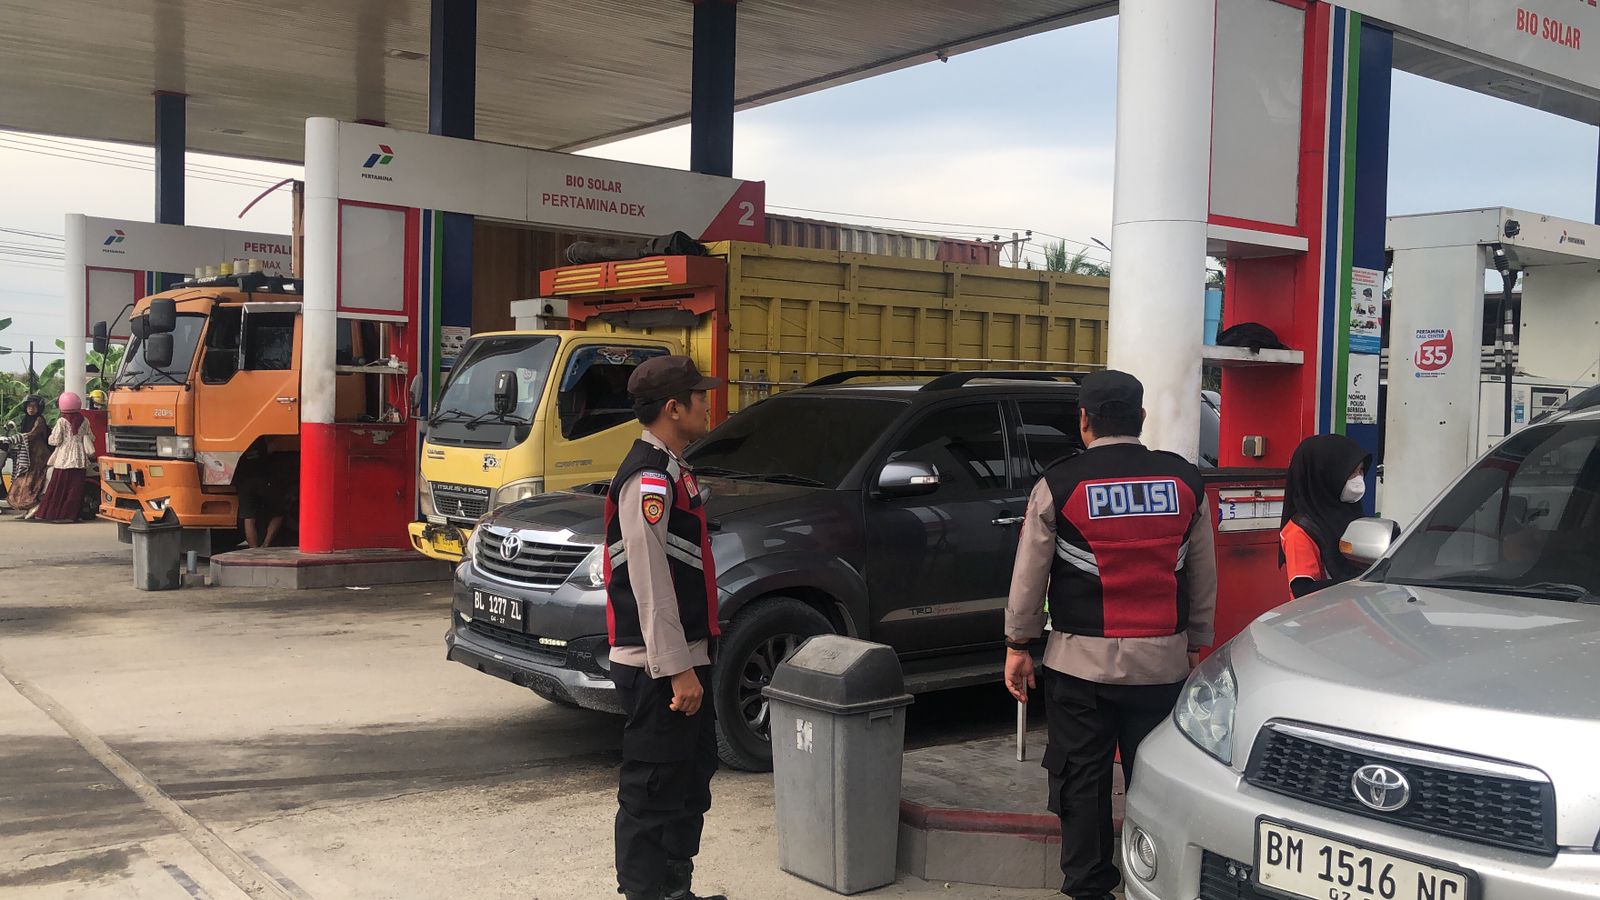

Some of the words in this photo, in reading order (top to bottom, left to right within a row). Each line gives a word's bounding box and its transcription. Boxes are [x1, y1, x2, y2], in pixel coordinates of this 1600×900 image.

[1516, 8, 1538, 36] BIO
[1542, 17, 1581, 50] SOLAR
[565, 174, 585, 188] BIO
[587, 178, 622, 193] SOLAR
[542, 192, 618, 214] PERTAMINA
[620, 202, 646, 218] DEX
[737, 201, 755, 227] 2
[1416, 345, 1447, 366] 135
[468, 486, 488, 495] FUSO
[1089, 482, 1176, 517] POLISI
[474, 591, 485, 611] BL
[488, 595, 507, 616] 1277
[510, 600, 522, 620] ZL
[909, 606, 933, 616] TRD
[1266, 830, 1304, 873] BM
[1317, 845, 1396, 900] 1516
